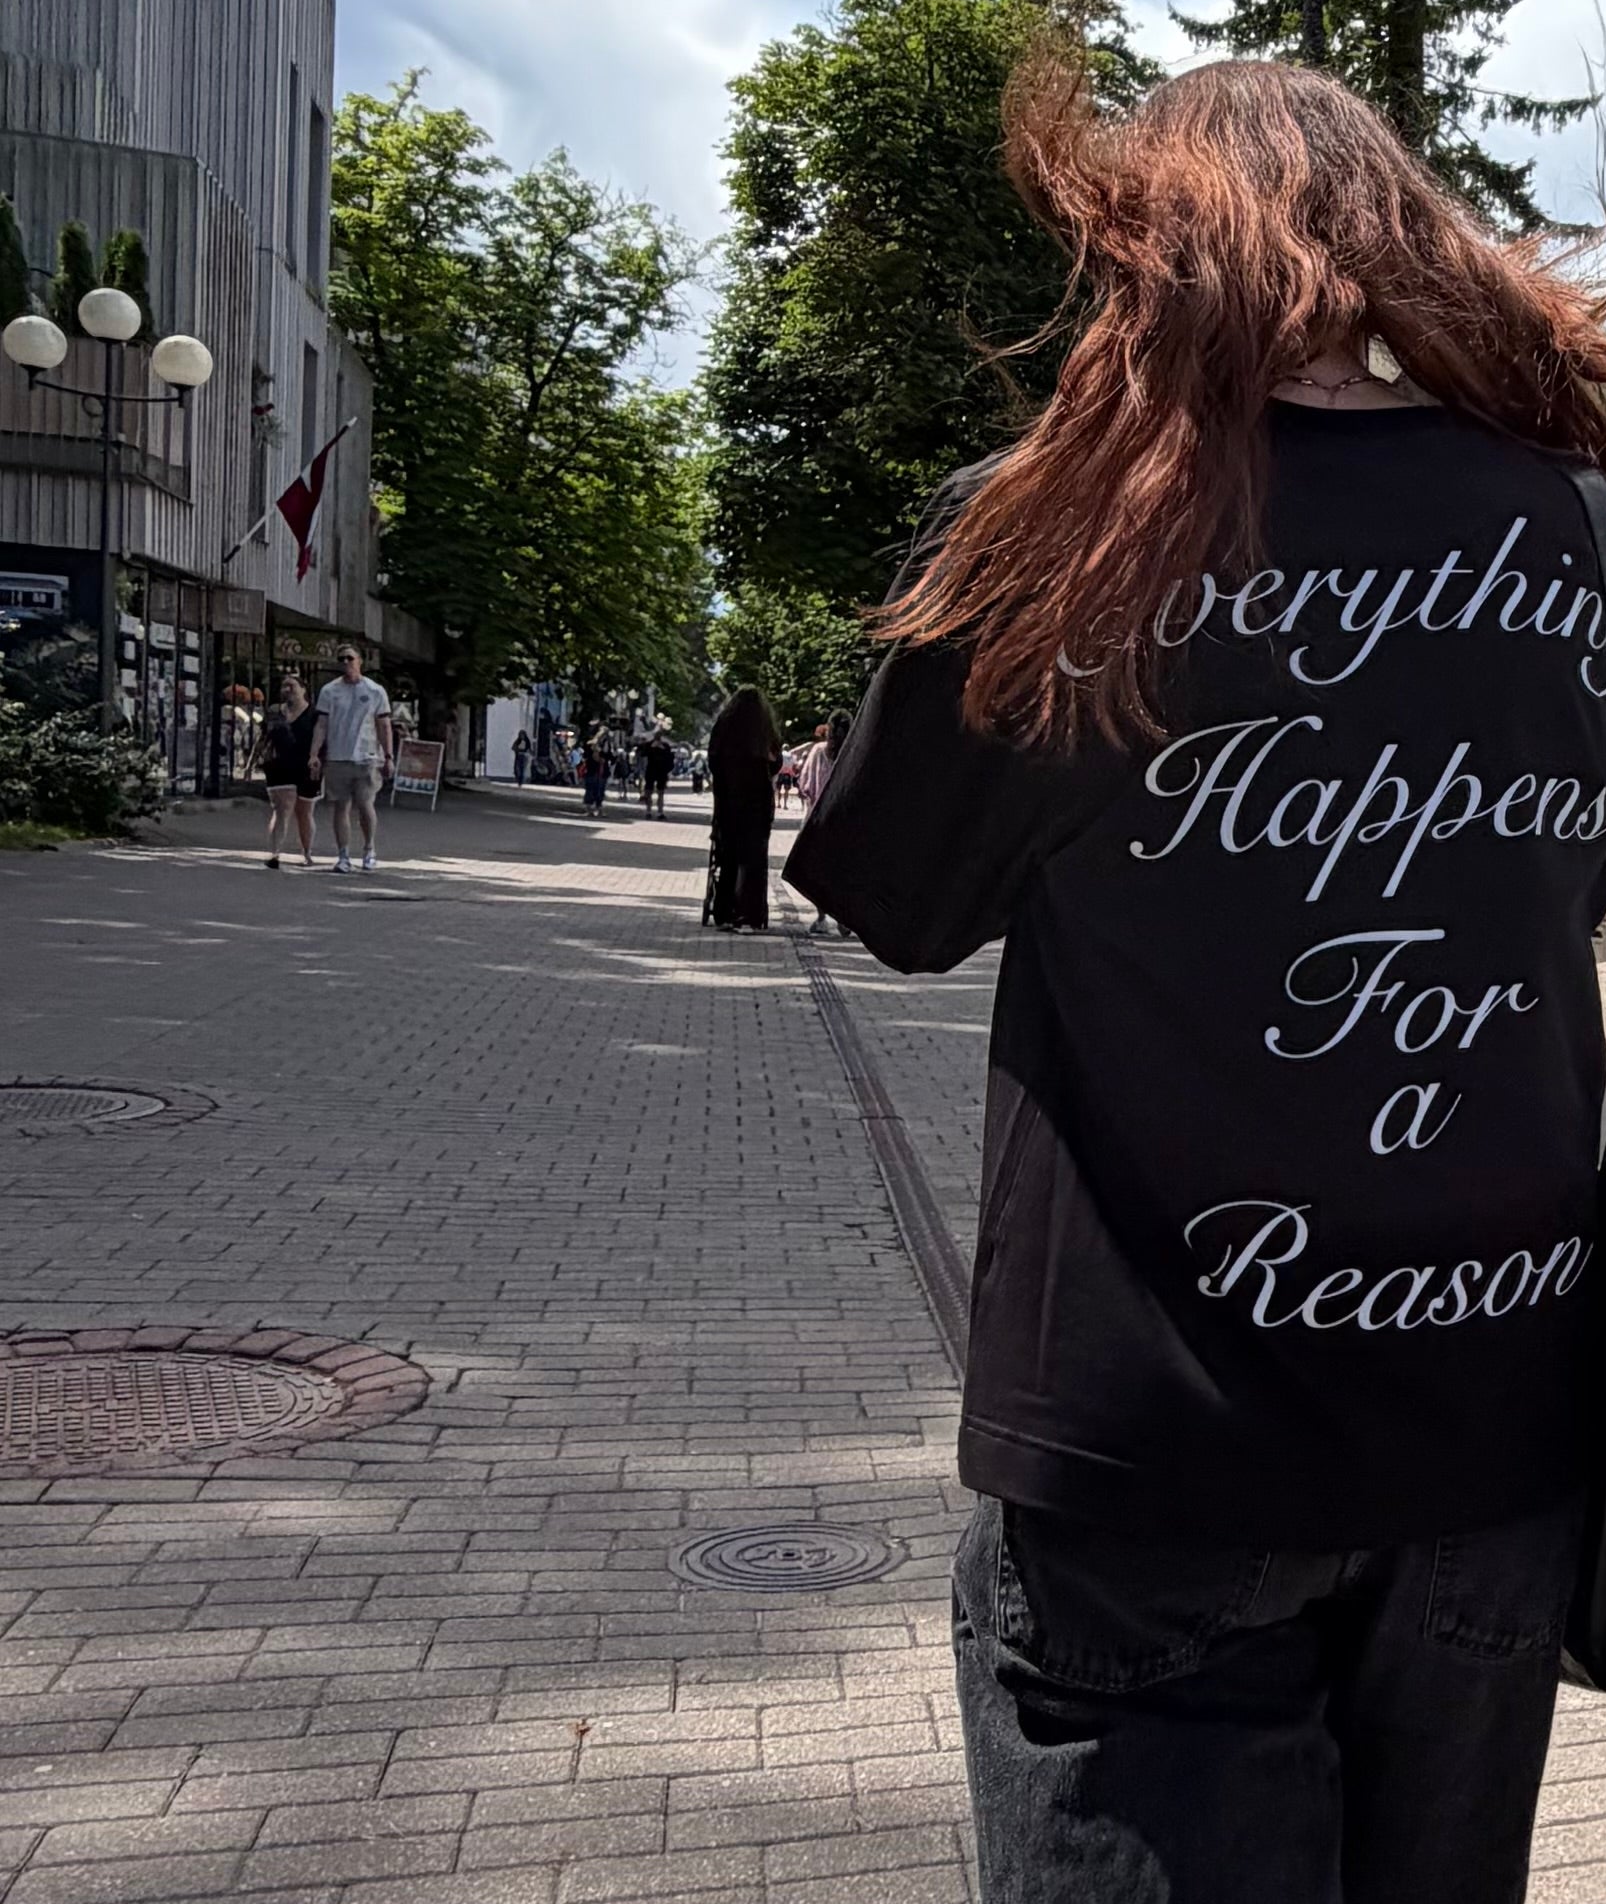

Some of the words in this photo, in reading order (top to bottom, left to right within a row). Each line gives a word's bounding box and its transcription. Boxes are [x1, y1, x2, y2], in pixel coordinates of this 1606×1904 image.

[1264, 928, 1539, 1059] For
[1368, 1082, 1462, 1155] a
[1183, 1199, 1594, 1331] Reason
